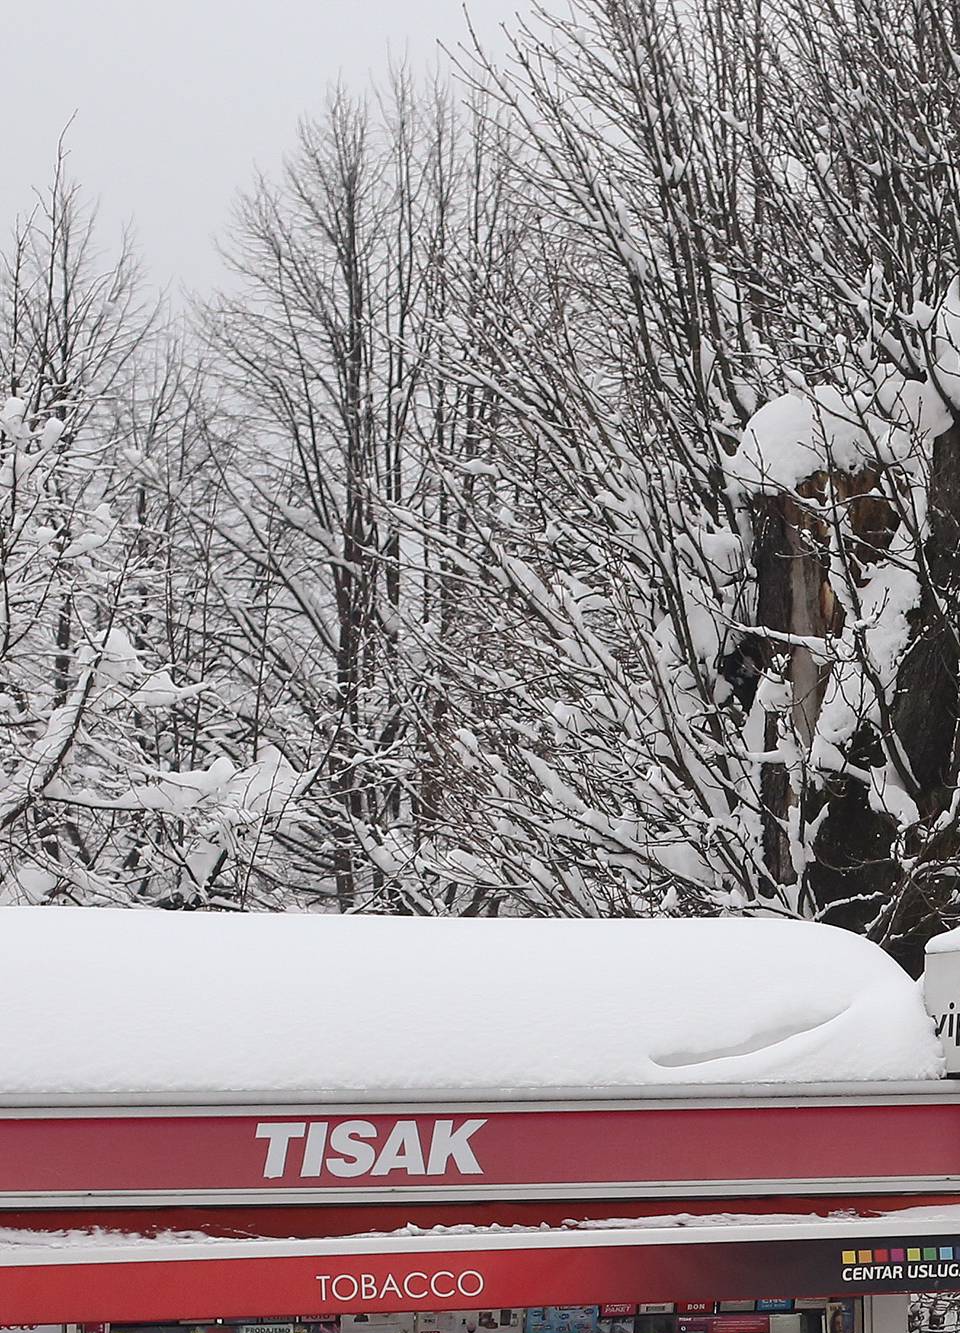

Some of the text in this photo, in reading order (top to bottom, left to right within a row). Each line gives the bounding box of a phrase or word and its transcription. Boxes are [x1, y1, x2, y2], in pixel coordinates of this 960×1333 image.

[255, 1118, 489, 1179] TISAK
[315, 1270, 484, 1301] TOBACCO
[842, 1265, 903, 1282] CENTAR
[687, 1303, 705, 1311] BON
